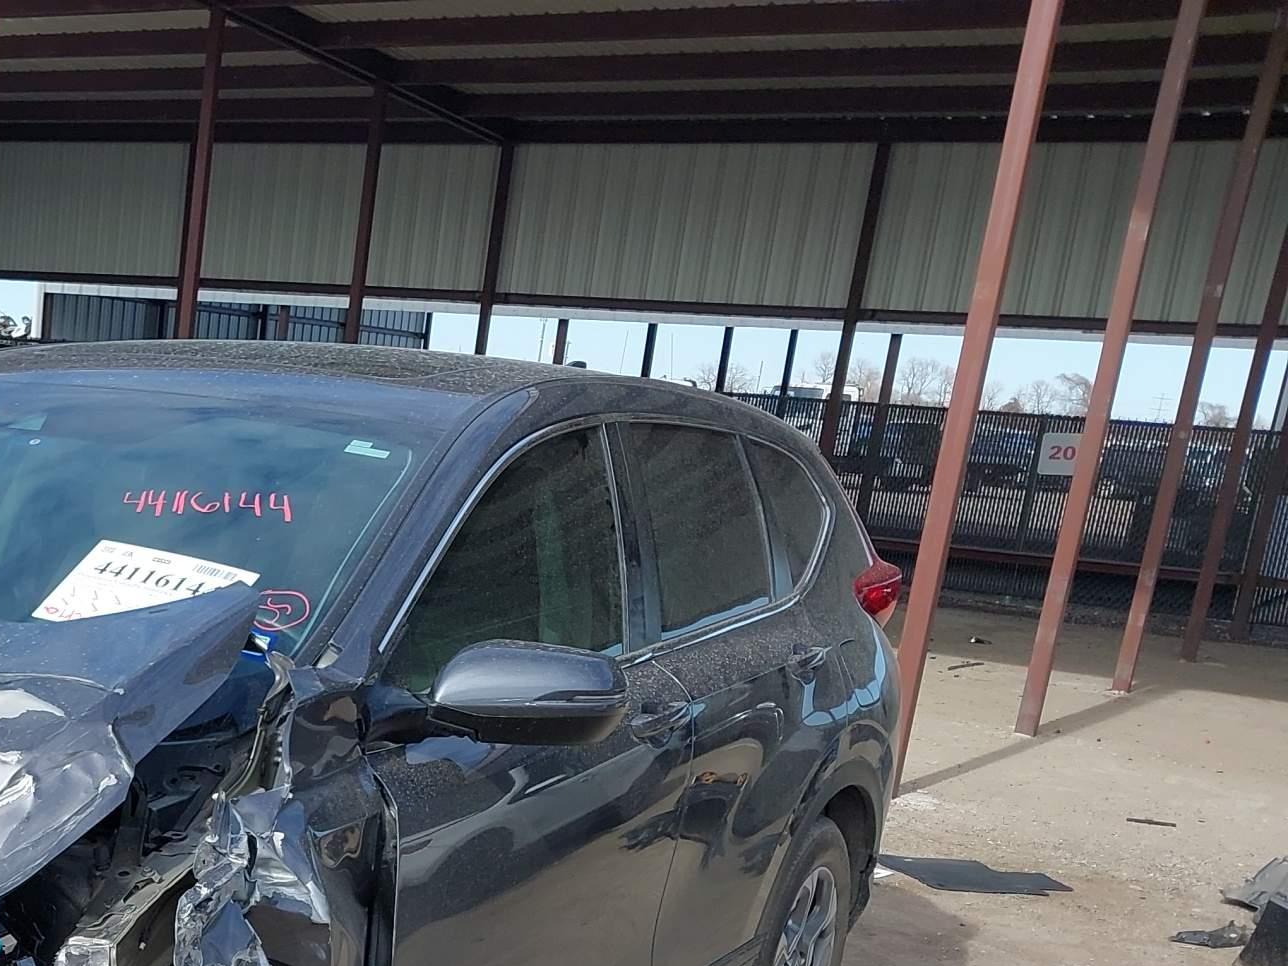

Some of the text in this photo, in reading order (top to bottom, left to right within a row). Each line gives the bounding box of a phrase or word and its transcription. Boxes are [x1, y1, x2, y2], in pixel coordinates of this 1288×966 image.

[1048, 445, 1077, 461] 20
[123, 489, 293, 523] 44116144
[93, 560, 220, 598] 4411614
